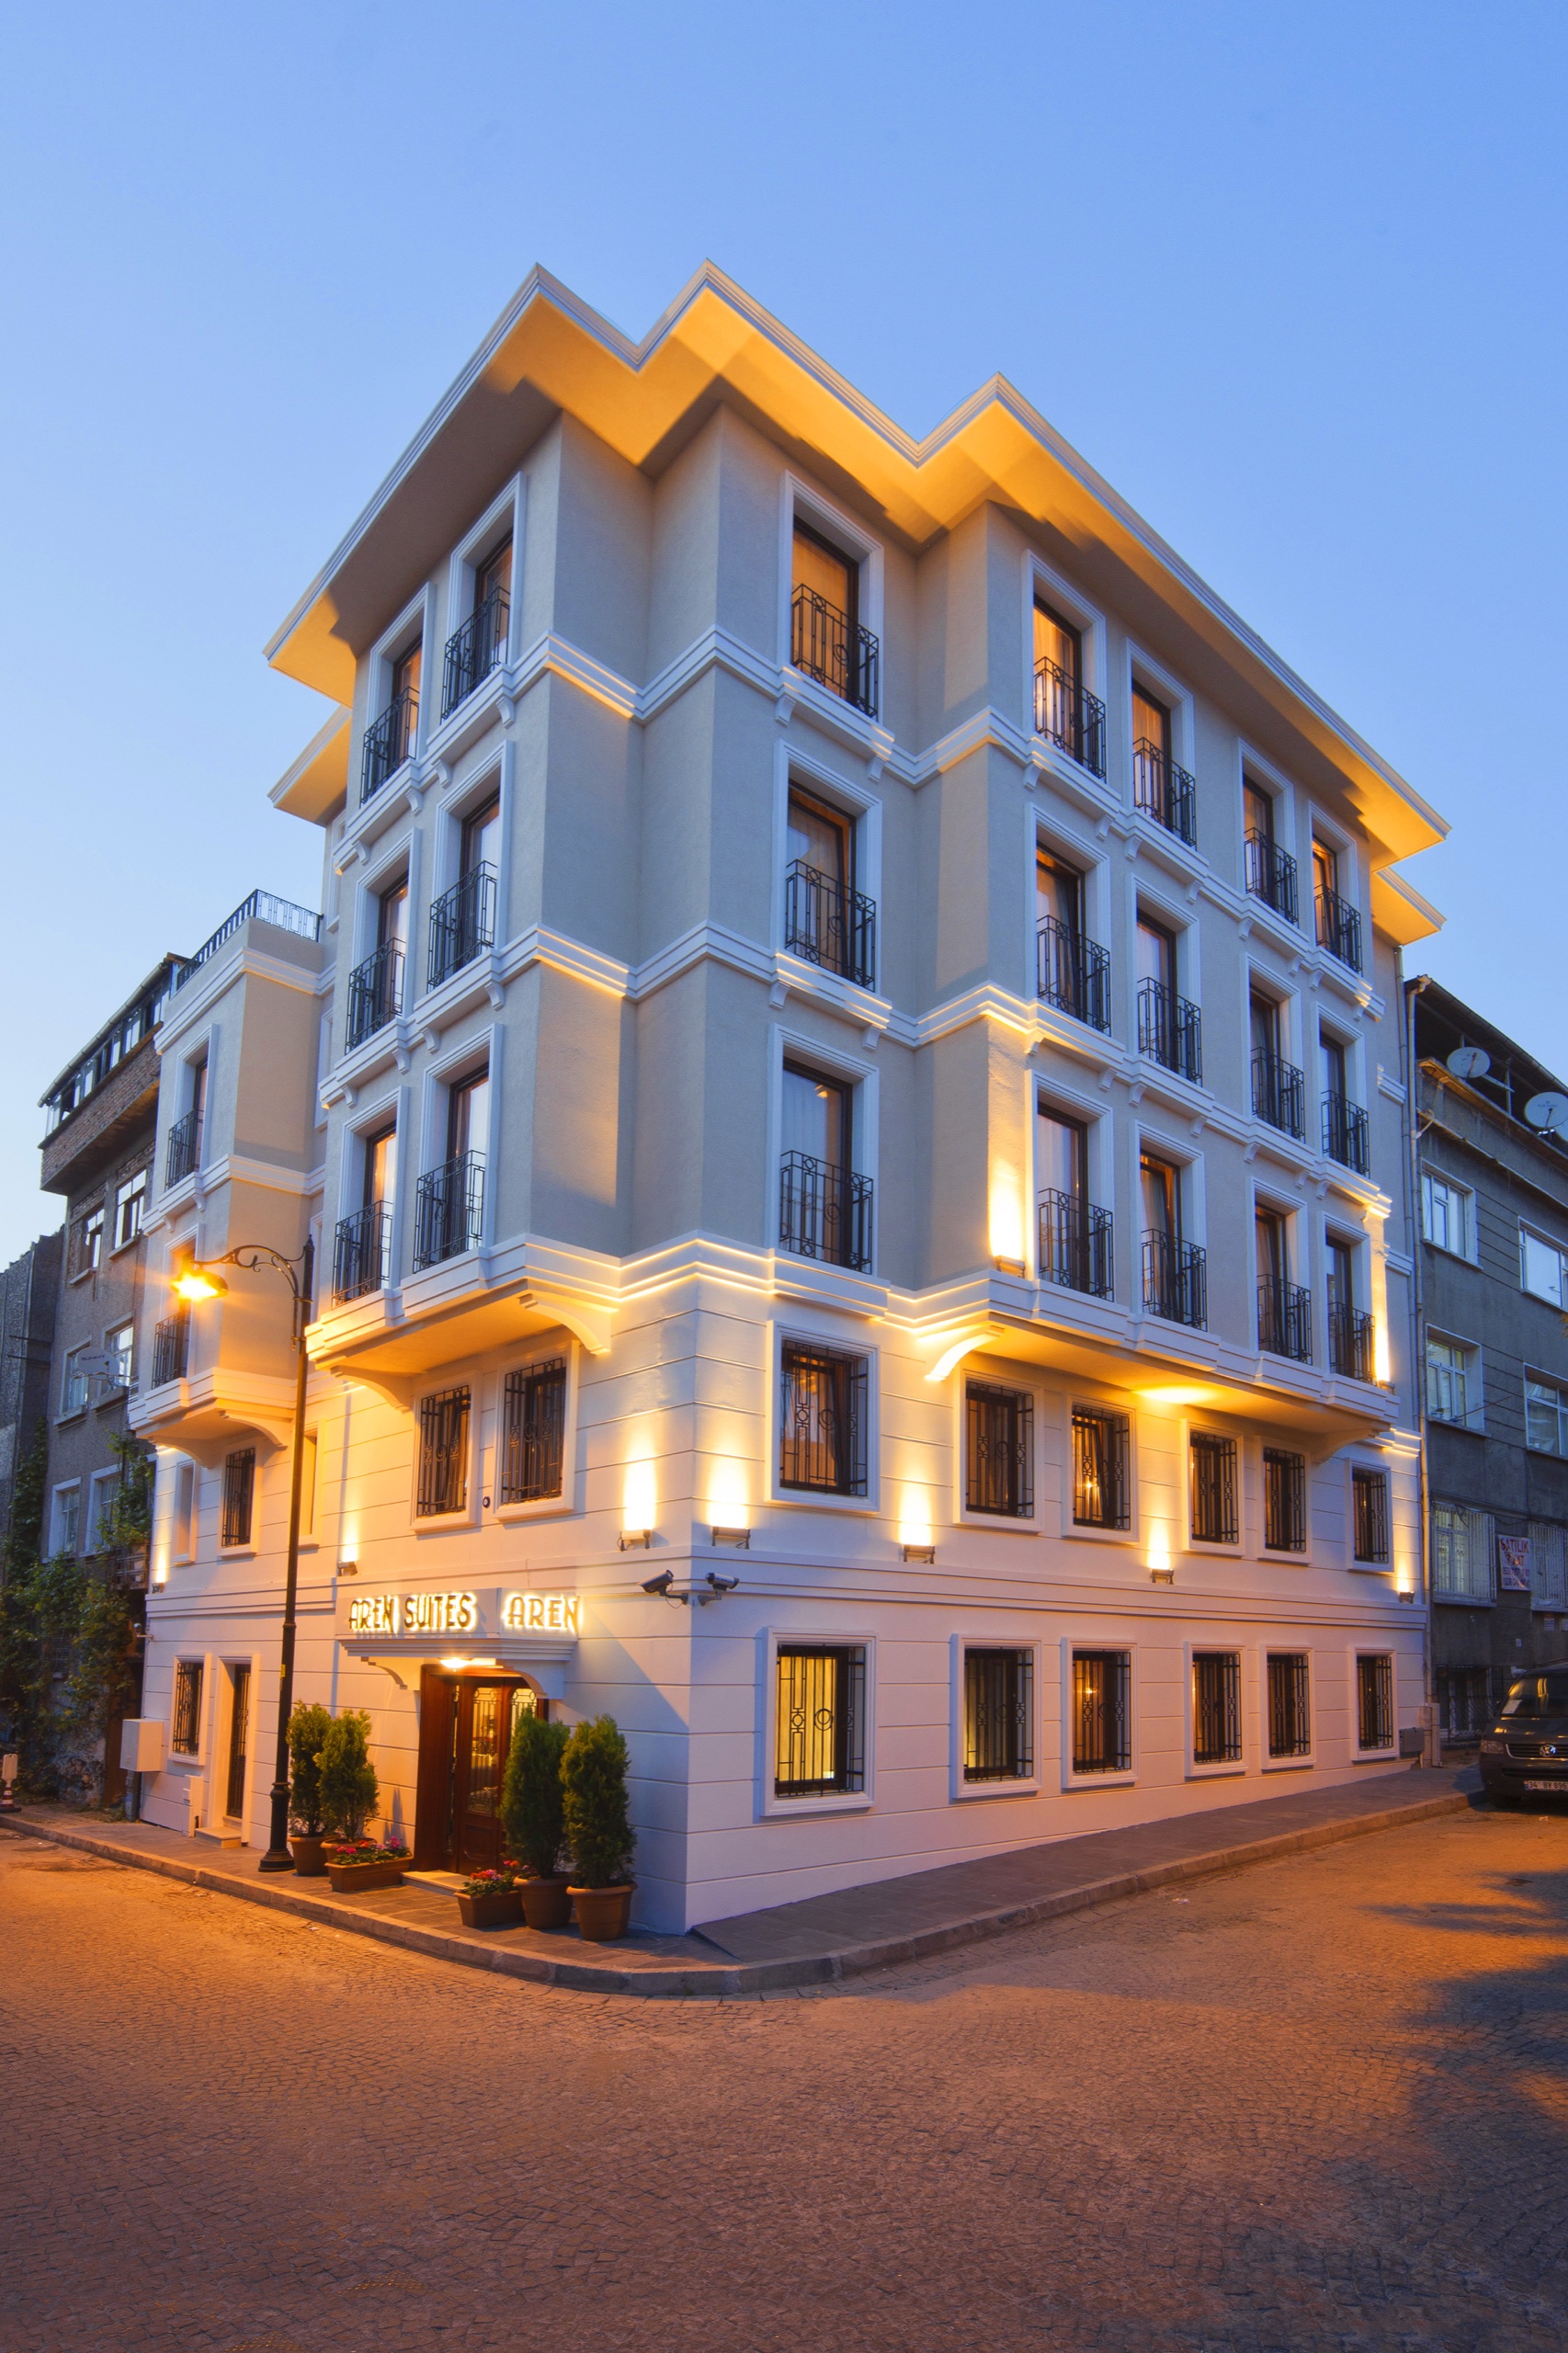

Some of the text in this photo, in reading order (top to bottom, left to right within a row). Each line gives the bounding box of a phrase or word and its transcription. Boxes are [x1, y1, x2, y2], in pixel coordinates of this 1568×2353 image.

[348, 1594, 473, 1633] AREN SUITES
[507, 1595, 580, 1633] AREN
